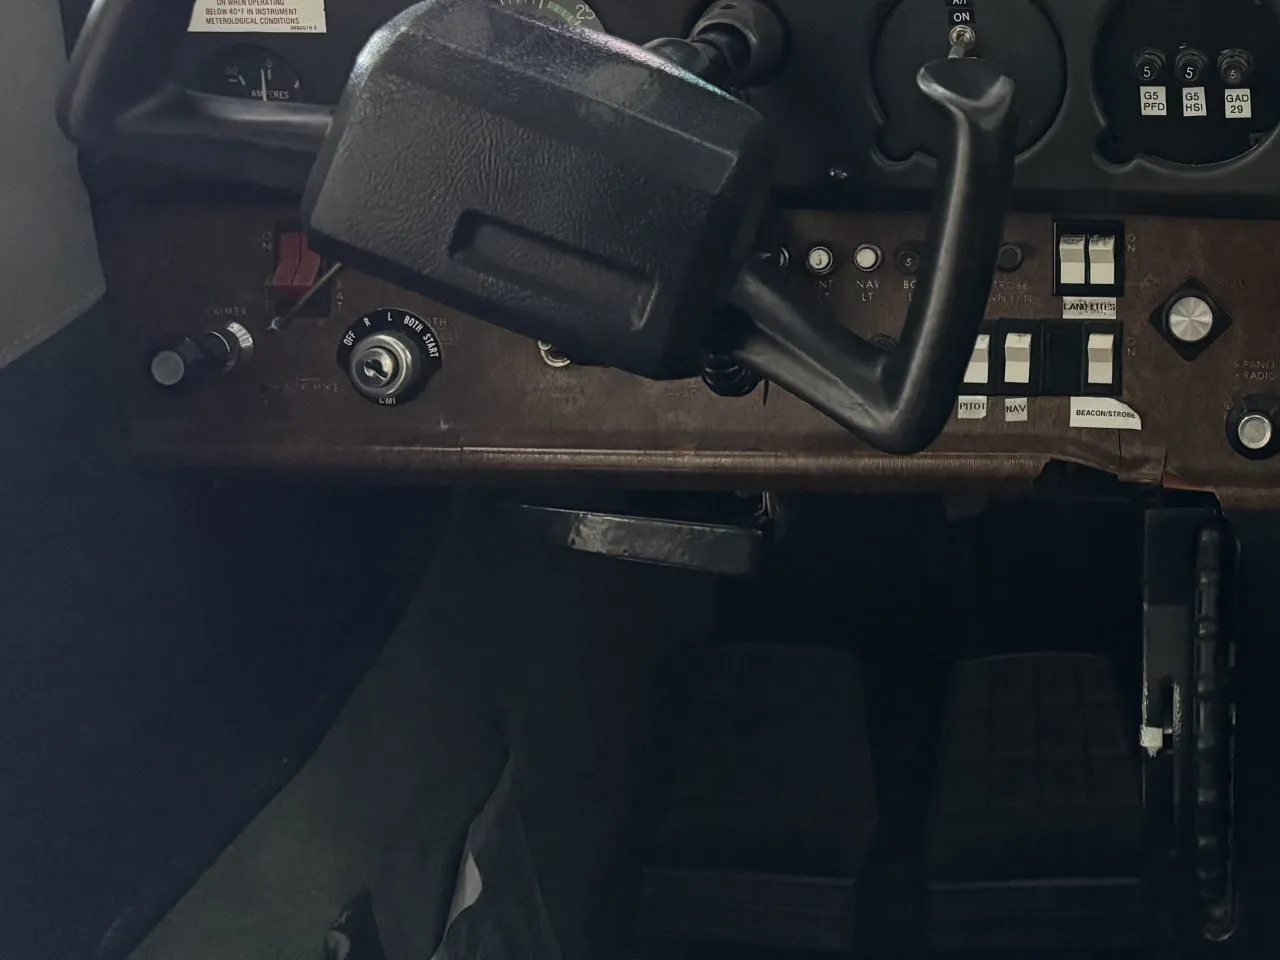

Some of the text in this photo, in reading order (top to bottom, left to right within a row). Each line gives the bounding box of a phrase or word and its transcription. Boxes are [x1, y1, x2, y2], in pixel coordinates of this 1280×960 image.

[205, 8, 228, 16] BELOW
[246, 8, 254, 16] IN
[255, 8, 297, 16] INSTRUMENT
[577, 4, 596, 20] 25
[953, 11, 970, 22] ON
[205, 17, 300, 25] METEROLOGICAL CONDITIONS
[1143, 91, 1159, 100] G5
[1185, 92, 1200, 101] G5
[1226, 94, 1249, 103] GAD
[1143, 102, 1165, 111] PFD
[1185, 103, 1203, 112] HSI
[1230, 105, 1243, 113] 29
[403, 315, 424, 333] BOTH
[343, 330, 357, 346] OFF
[422, 332, 439, 358] START
[1007, 405, 1027, 414] NAV
[1076, 409, 1137, 419] BEACON/STROBE
